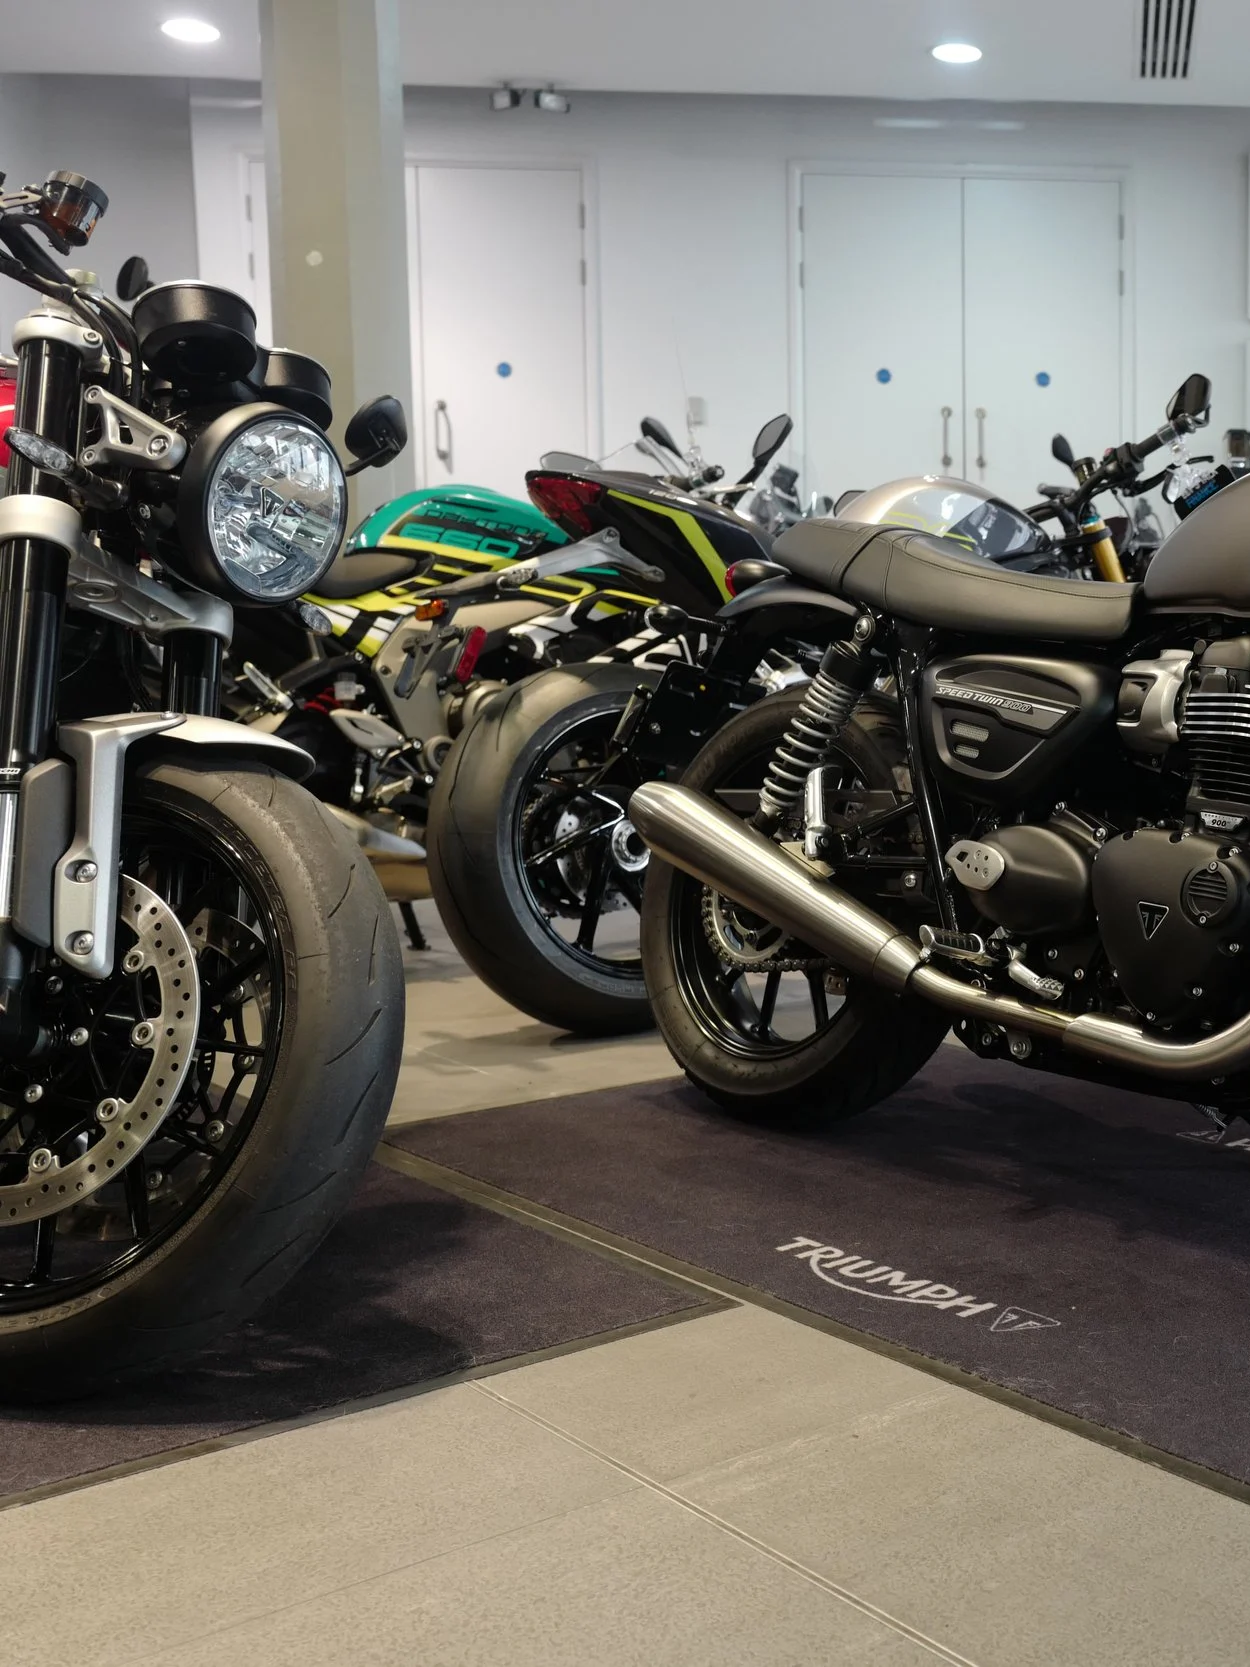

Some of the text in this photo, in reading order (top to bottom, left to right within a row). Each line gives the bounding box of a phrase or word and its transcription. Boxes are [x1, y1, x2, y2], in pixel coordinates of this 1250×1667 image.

[400, 522, 520, 559] 660
[935, 686, 1033, 713] SPEED TWIN 900
[1211, 818, 1227, 827] 900
[775, 1235, 998, 1318] TRIUMPH
